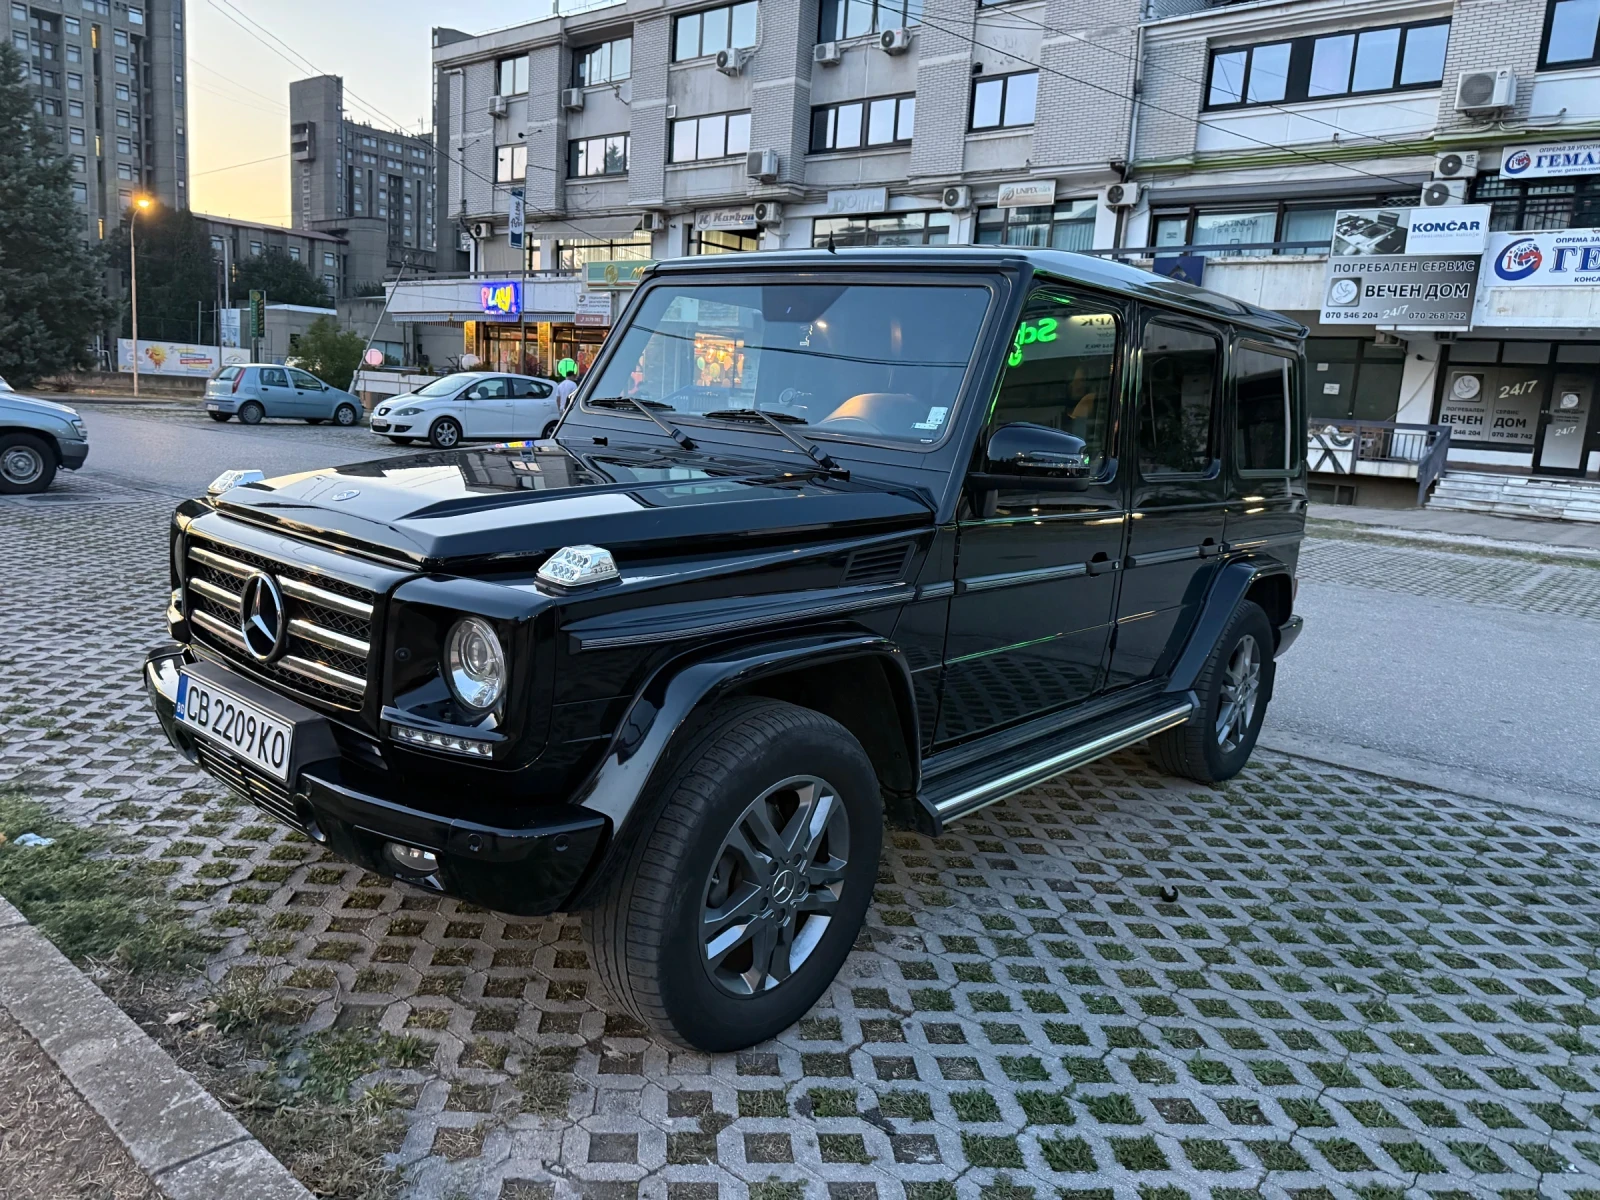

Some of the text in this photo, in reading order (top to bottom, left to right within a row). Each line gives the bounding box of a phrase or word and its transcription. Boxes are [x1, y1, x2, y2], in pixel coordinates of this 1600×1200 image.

[1534, 151, 1600, 169] ГЕМА
[1212, 219, 1257, 228] PLATINUM
[1411, 219, 1480, 233] KONČAR
[1333, 260, 1475, 273] ПОГРЕБАЛЕН СЕРВИС
[1364, 282, 1471, 301] ВЕЧЕН ДОМ
[1325, 311, 1379, 319] 070 546 204
[1382, 304, 1409, 319] 24/7
[1408, 312, 1467, 320] 070 268 742
[1498, 379, 1538, 399] 24/7
[1441, 414, 1527, 428] ВЕЧЕН ДОМ
[1555, 425, 1577, 436] 24/7
[176, 701, 185, 715] BG
